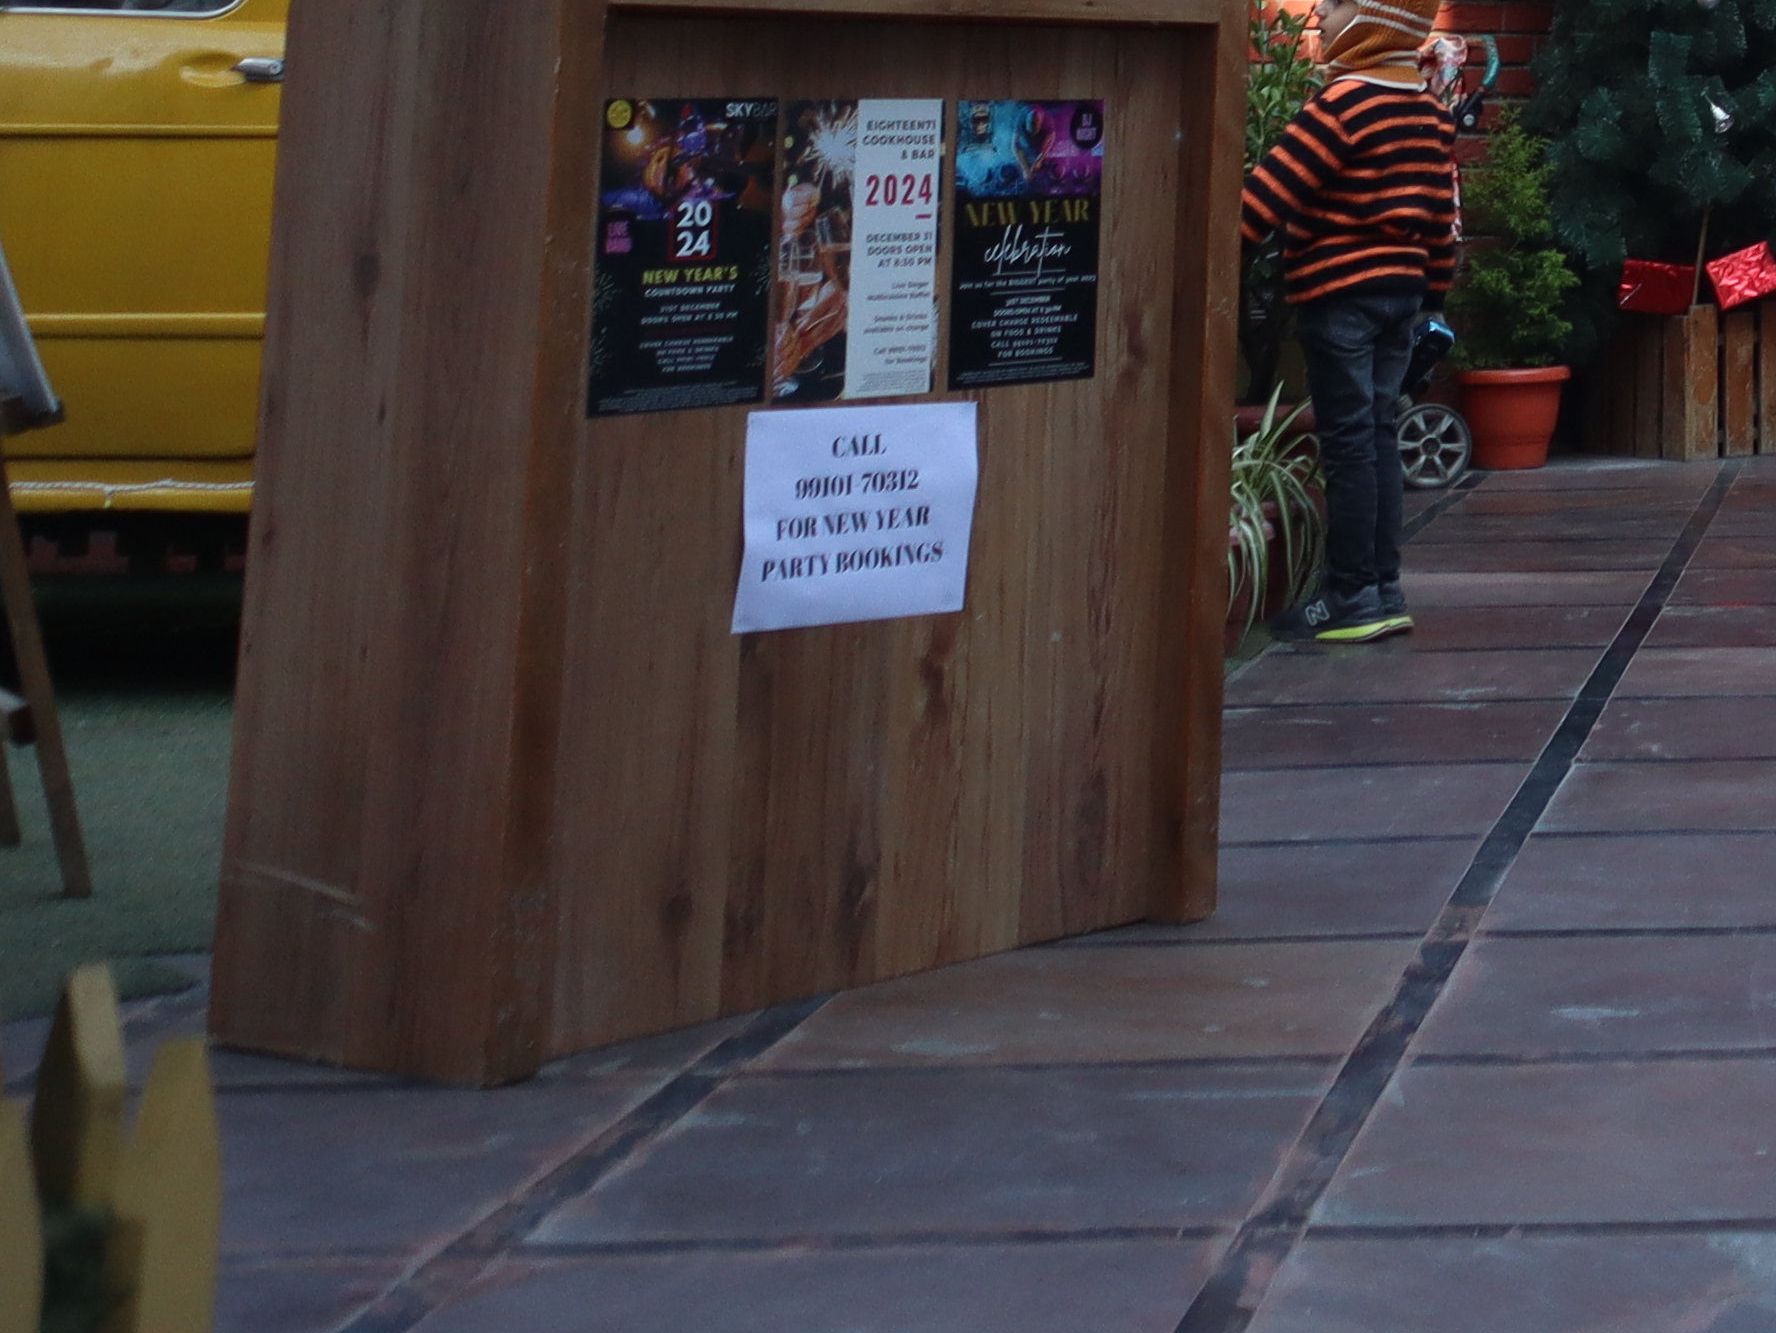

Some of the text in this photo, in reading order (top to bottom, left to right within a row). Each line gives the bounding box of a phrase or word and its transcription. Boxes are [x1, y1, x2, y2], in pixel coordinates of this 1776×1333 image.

[862, 134, 935, 146] COOKHOUSE
[911, 149, 935, 160] BAR
[865, 173, 933, 206] 2024
[676, 201, 712, 228] 20
[965, 199, 1089, 227] NEW YEAR
[675, 230, 711, 258] 24
[866, 232, 920, 243] DECEMBER
[867, 244, 932, 256] DOORS OPEN
[877, 258, 891, 268] AT
[916, 256, 932, 266] PM
[642, 265, 739, 284] NEW YEAR'S
[644, 283, 736, 298] COUNTDOWN PARTY
[679, 302, 721, 311] DECEMBER
[671, 314, 692, 322] OPEN
[832, 433, 887, 459] CALL
[795, 469, 919, 500] 99101-70312
[776, 505, 931, 541] FOR NEW YEAR
[760, 540, 945, 583] PARTY BOOKINGS
[1305, 599, 1330, 626] N
